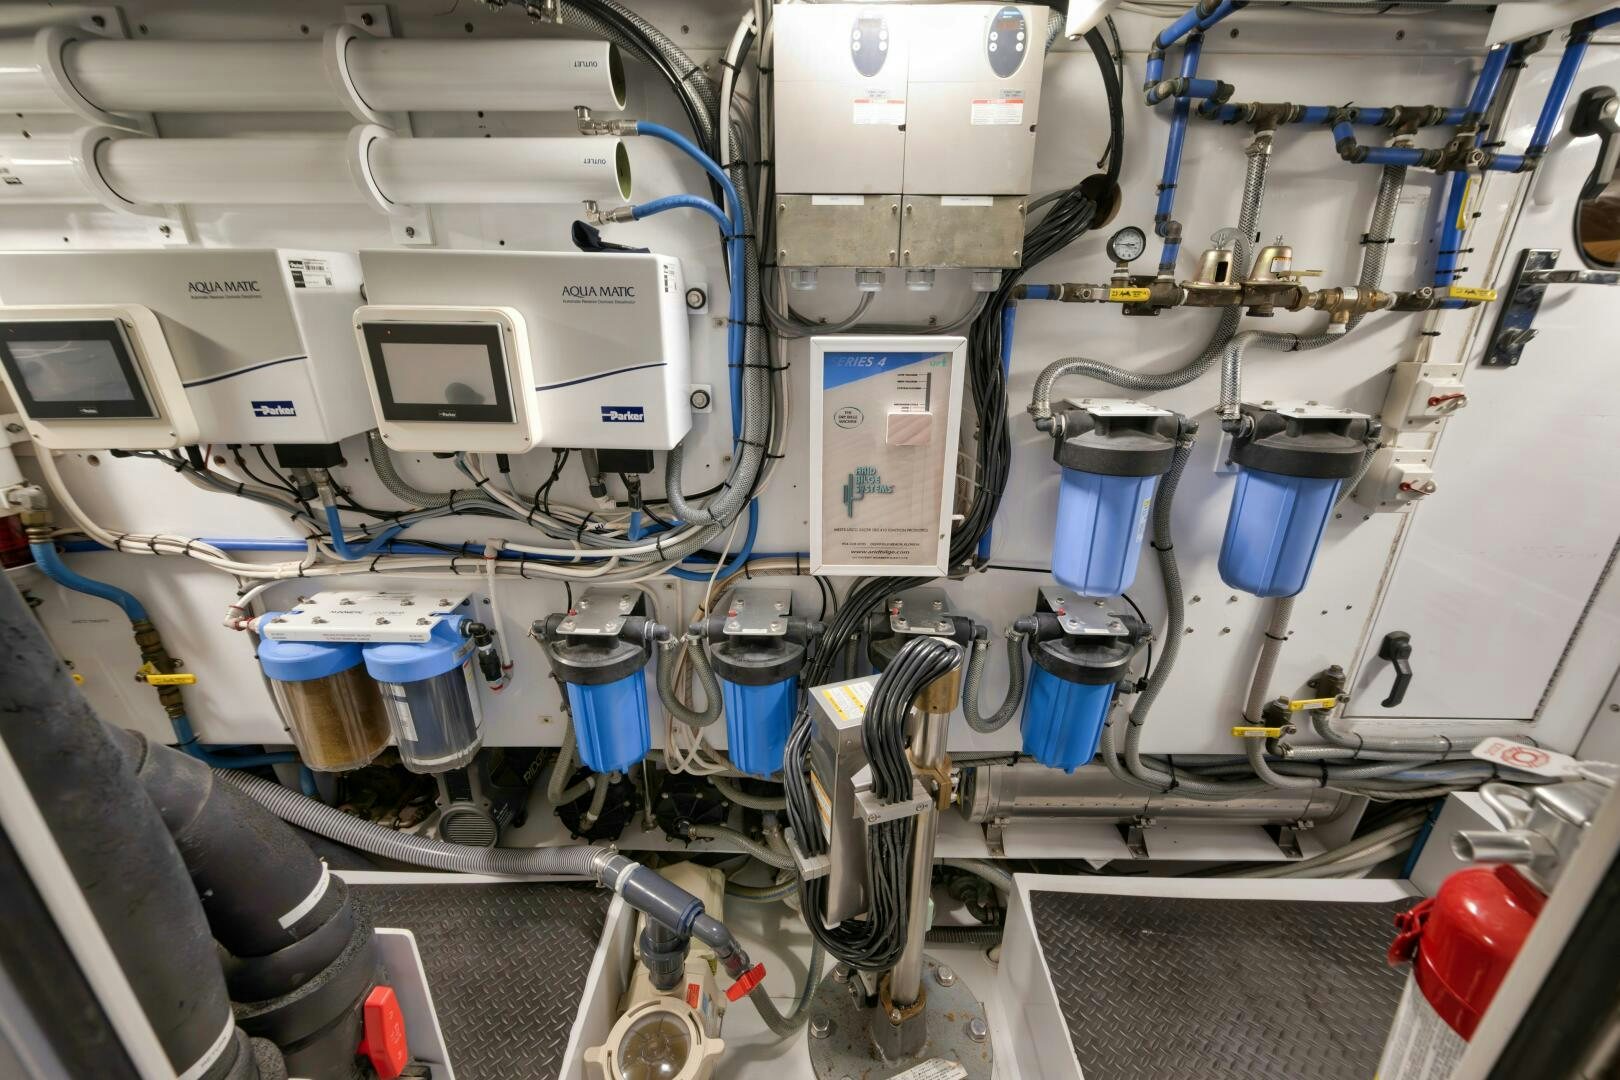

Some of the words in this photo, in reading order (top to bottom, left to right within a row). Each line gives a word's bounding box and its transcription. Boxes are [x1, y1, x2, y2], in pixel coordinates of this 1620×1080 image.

[573, 60, 598, 68] OUTLET
[188, 281, 223, 294] AQUA
[224, 281, 260, 292] MATIC
[562, 285, 598, 298] AQUA
[600, 286, 635, 297] MATIC
[878, 356, 887, 367] 4
[260, 404, 296, 416] Parker
[609, 410, 644, 421] Parker
[856, 466, 877, 476] ARID
[856, 476, 881, 485] BILGE
[856, 485, 894, 494] SYSTEMS
